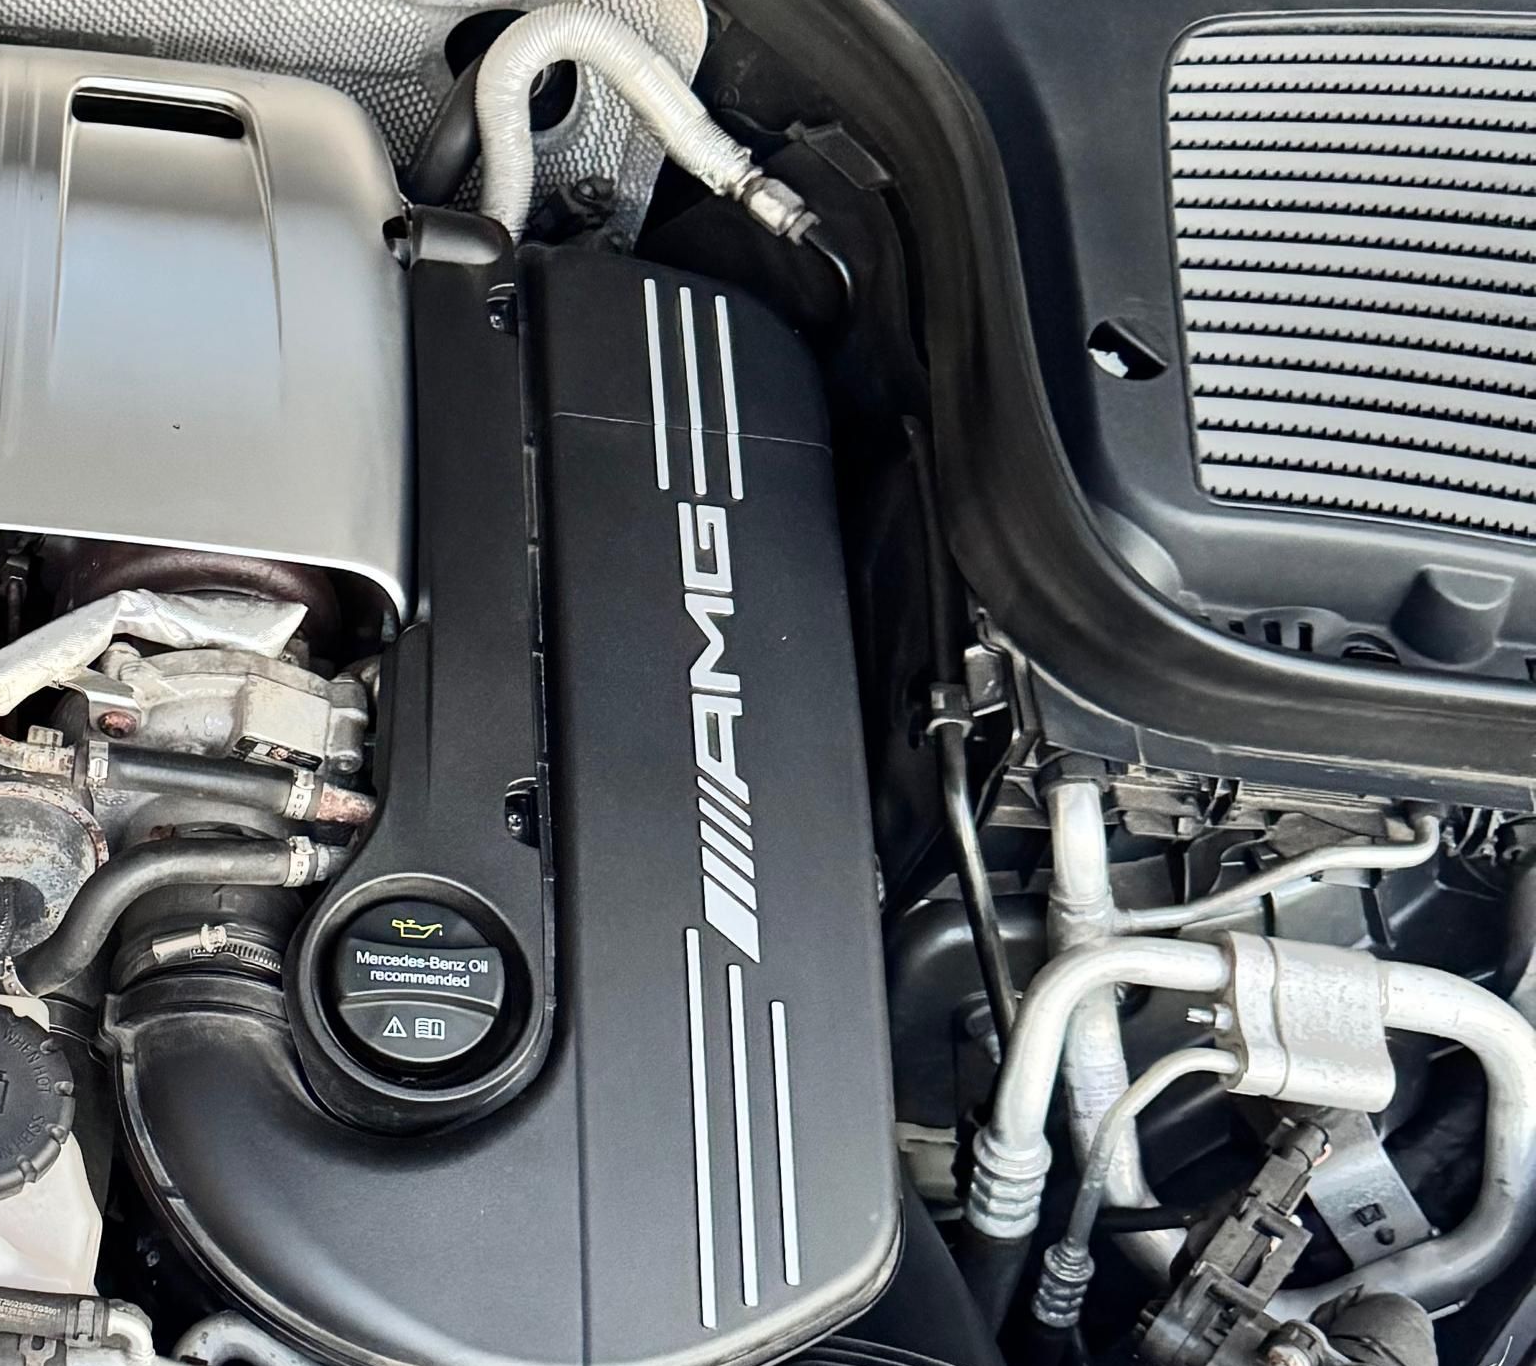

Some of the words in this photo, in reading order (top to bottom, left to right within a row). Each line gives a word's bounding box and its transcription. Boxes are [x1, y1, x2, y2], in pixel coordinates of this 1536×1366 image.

[678, 501, 751, 805] AMG
[357, 951, 465, 972] Mercedes-Benz
[469, 961, 488, 973] Oil
[370, 970, 470, 988] recommended
[3, 1028, 42, 1064] WHEN
[34, 1064, 51, 1094] HOT
